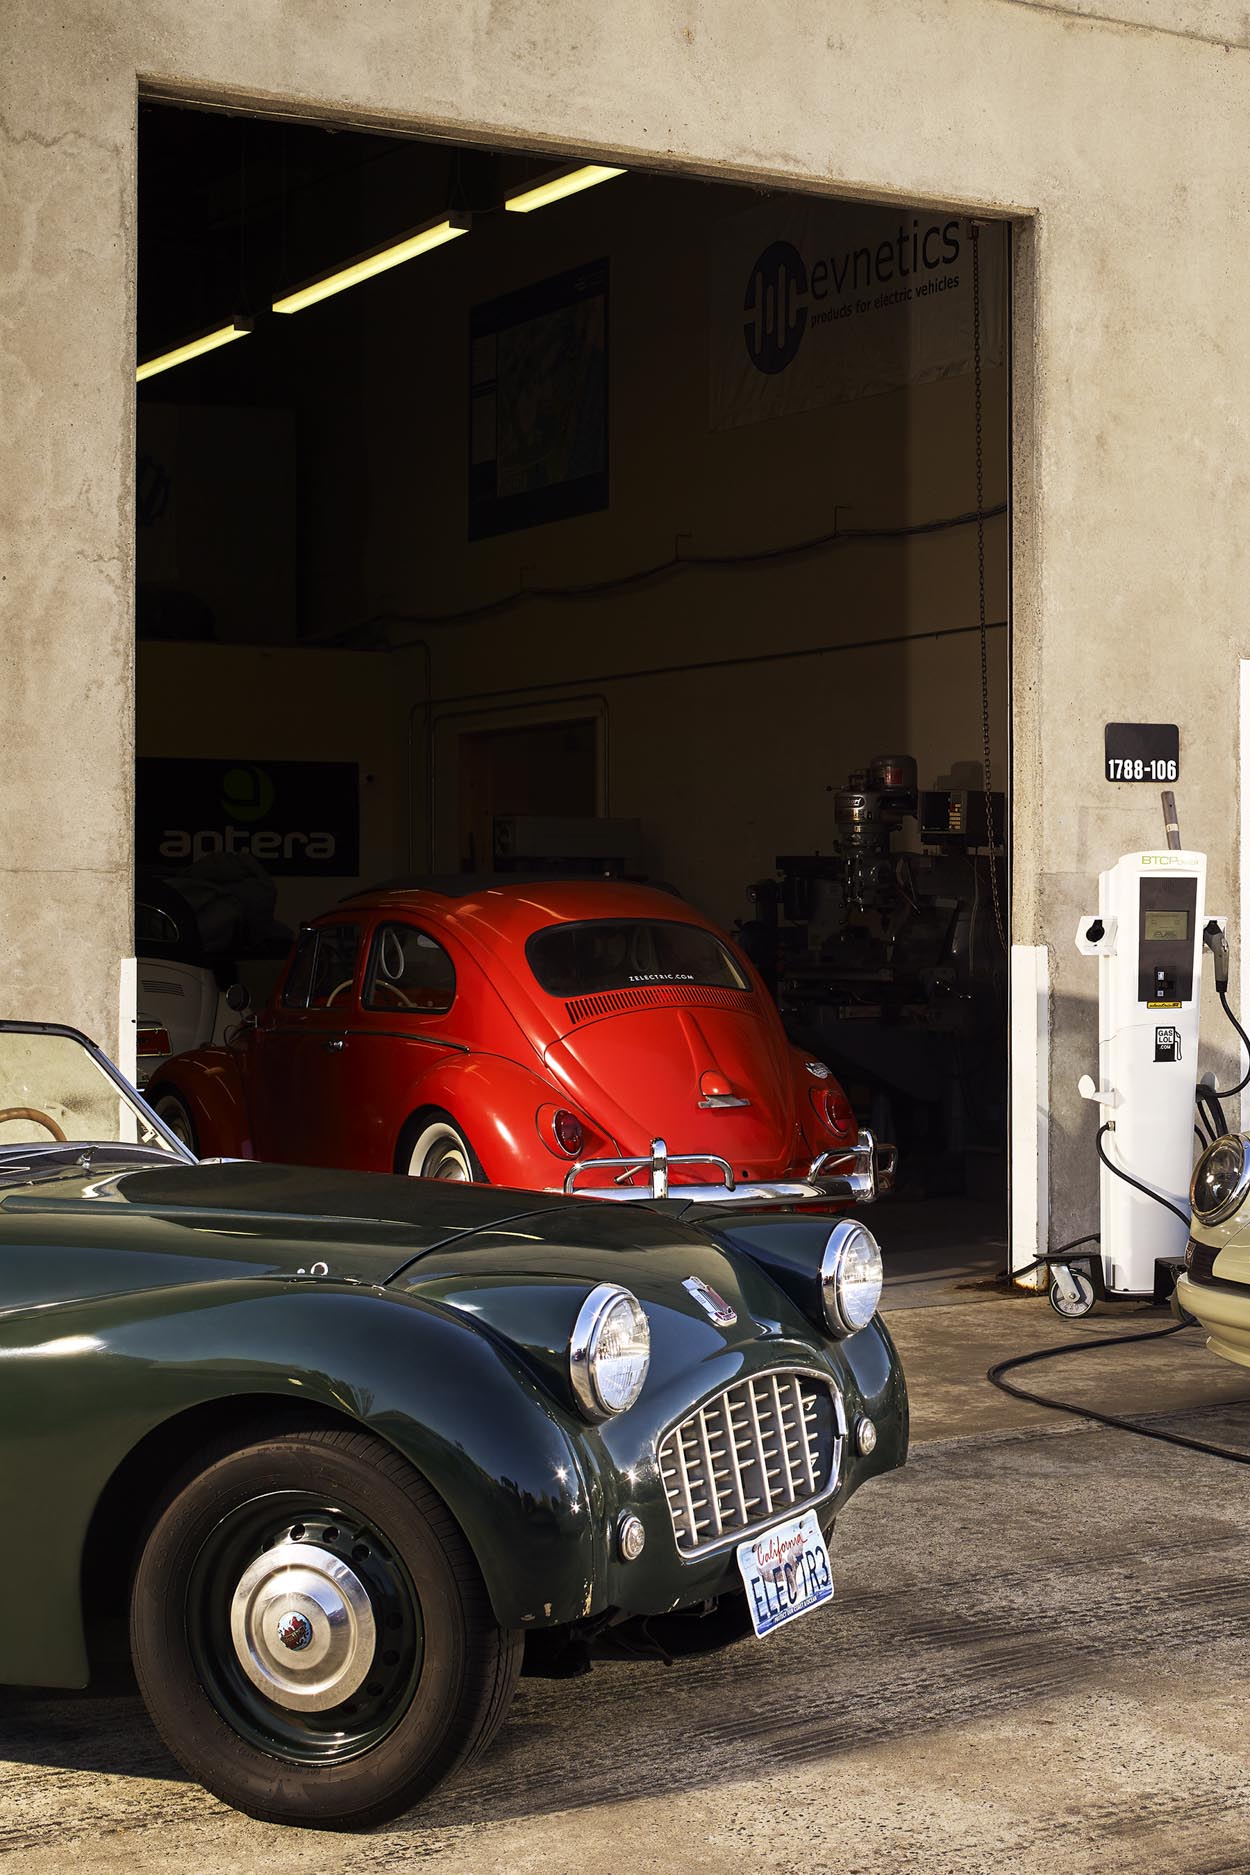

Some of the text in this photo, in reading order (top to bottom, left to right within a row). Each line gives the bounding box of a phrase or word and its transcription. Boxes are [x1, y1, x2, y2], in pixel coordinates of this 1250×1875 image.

[811, 220, 960, 300] evnetics
[811, 275, 960, 328] products for electric vehicles
[1108, 759, 1177, 780] 1788-106
[159, 824, 337, 863] aptera
[628, 973, 694, 982] ZELECTRIC.COM
[756, 1532, 808, 1566] California
